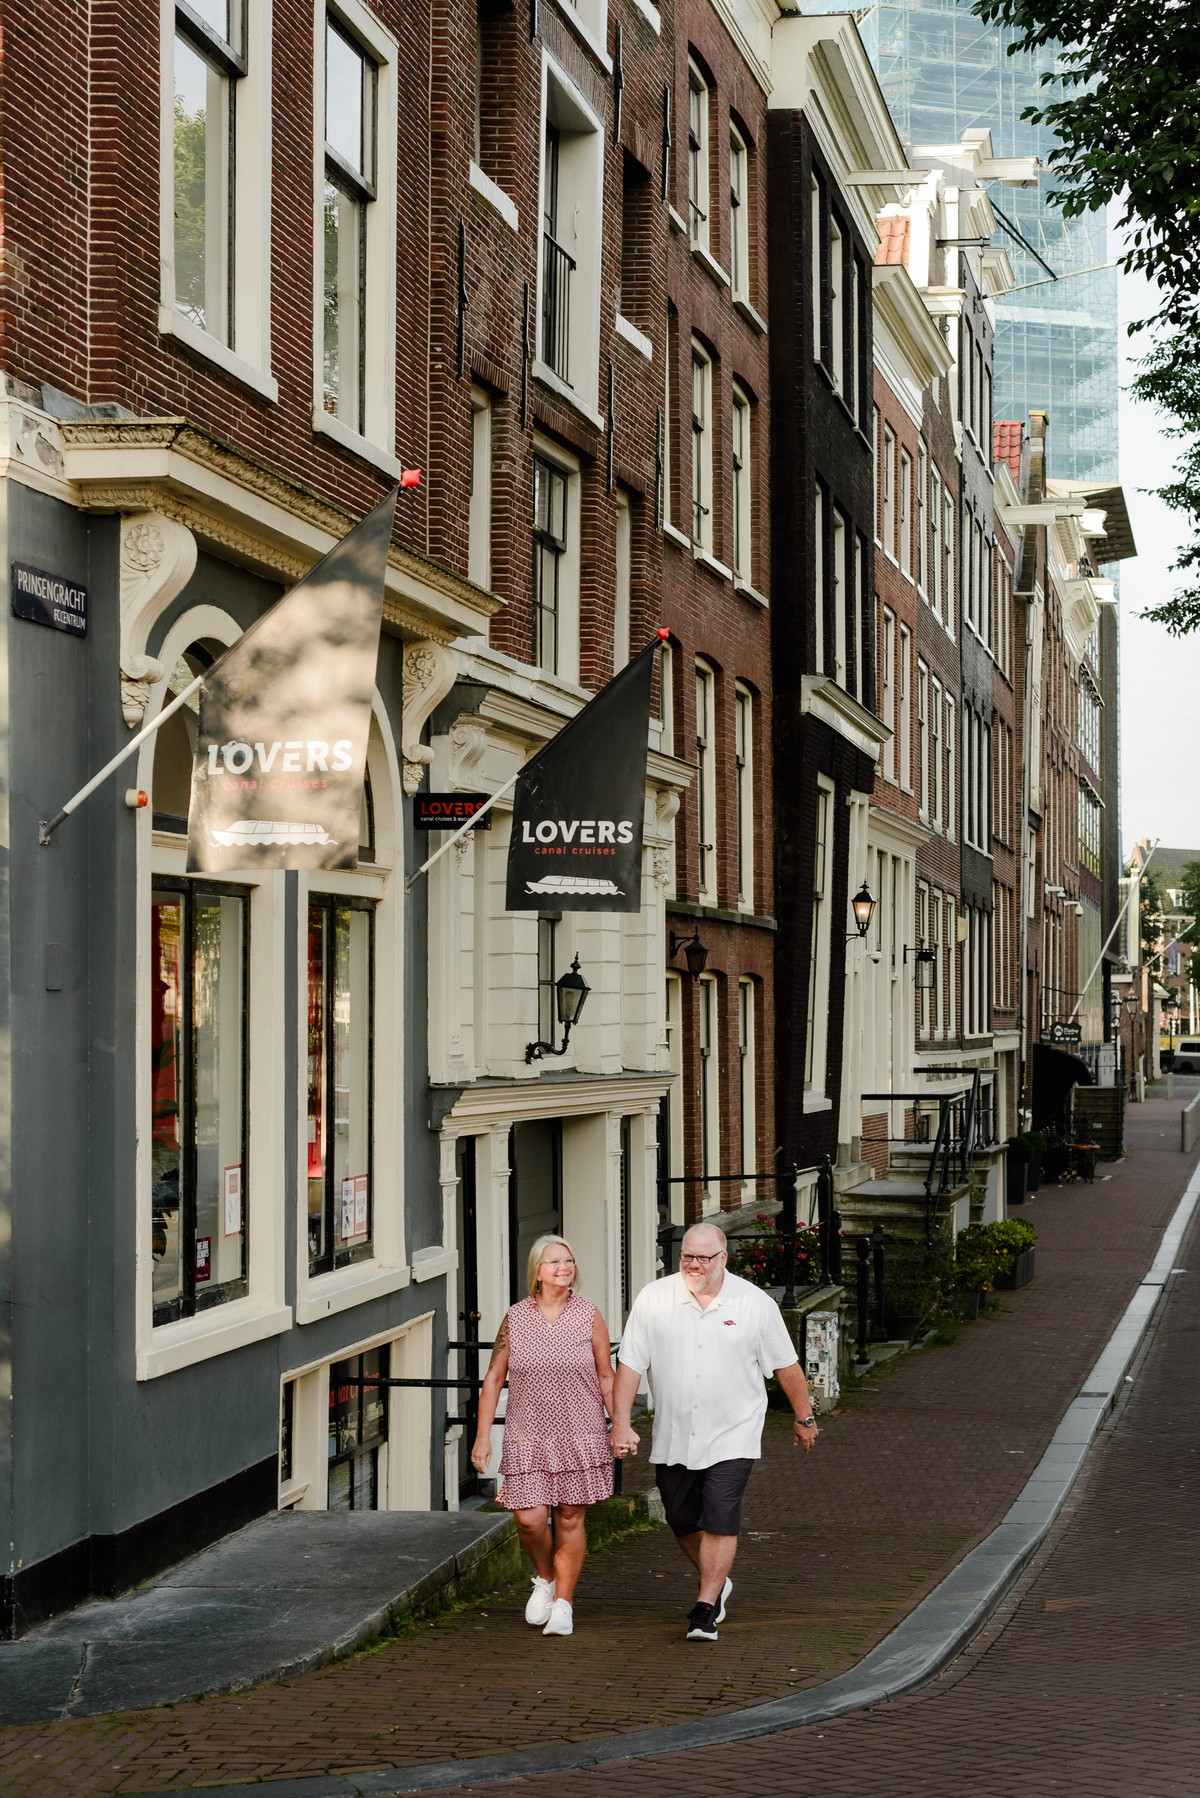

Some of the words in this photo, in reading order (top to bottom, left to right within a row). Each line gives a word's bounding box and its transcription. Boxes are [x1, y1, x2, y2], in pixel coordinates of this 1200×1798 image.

[17, 569, 86, 612] PRINSENGRACHT
[207, 739, 353, 775] LOVERS
[222, 778, 263, 791] canal
[270, 777, 328, 790] cruises
[522, 820, 634, 844] LOVERS
[534, 846, 567, 855] canal
[571, 846, 616, 855] cruises
